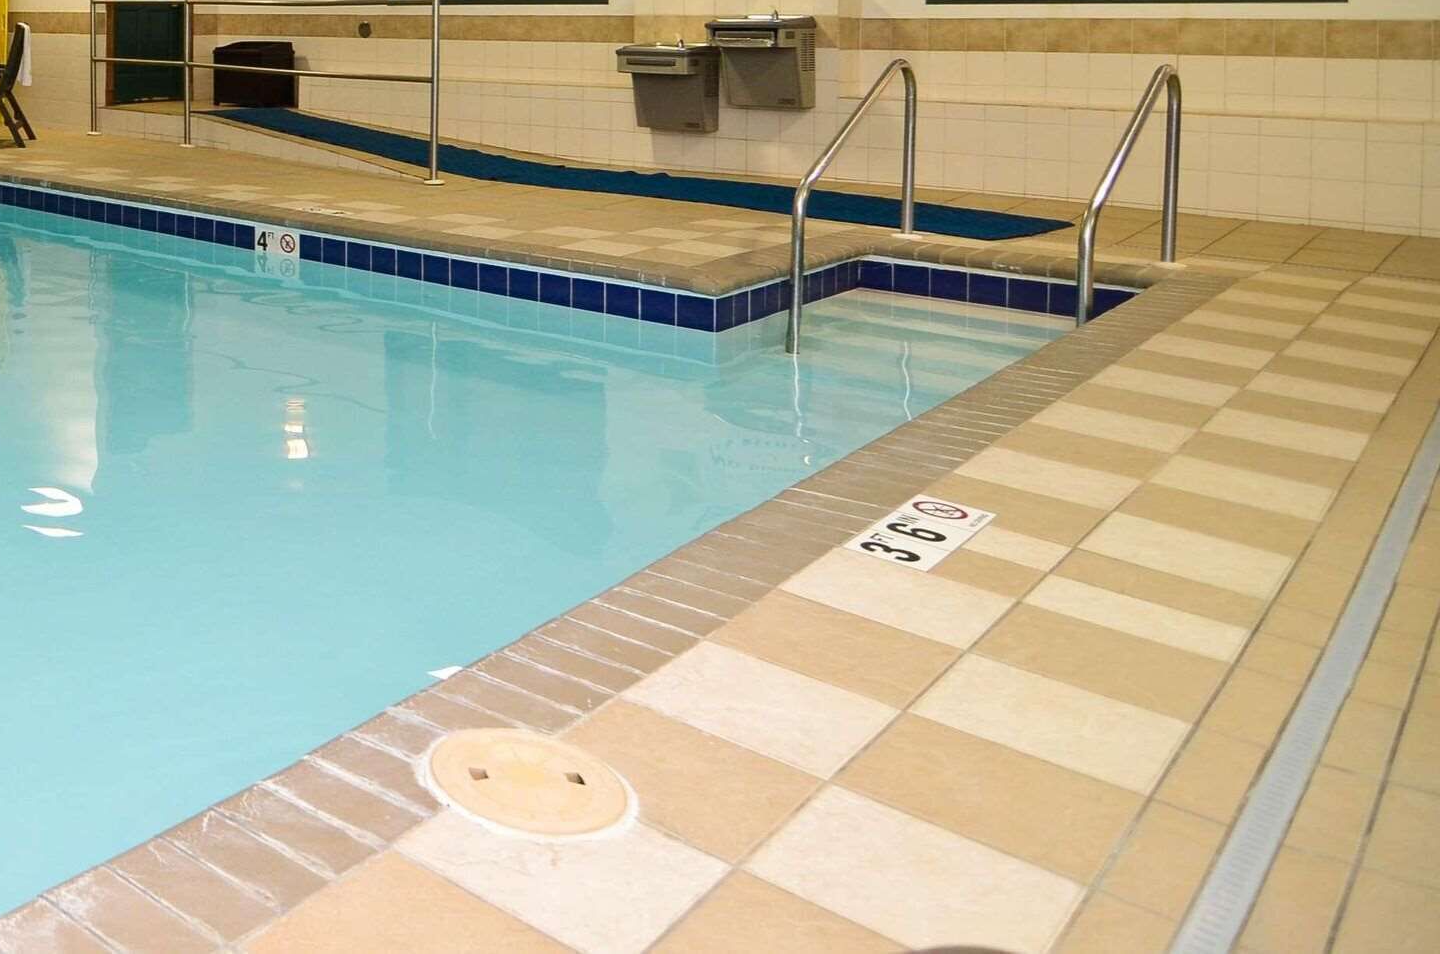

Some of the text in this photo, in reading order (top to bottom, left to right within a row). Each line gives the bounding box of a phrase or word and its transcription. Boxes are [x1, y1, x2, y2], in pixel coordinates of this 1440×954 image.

[257, 231, 268, 251] 4
[886, 522, 947, 542] 6
[860, 541, 921, 562] 3
